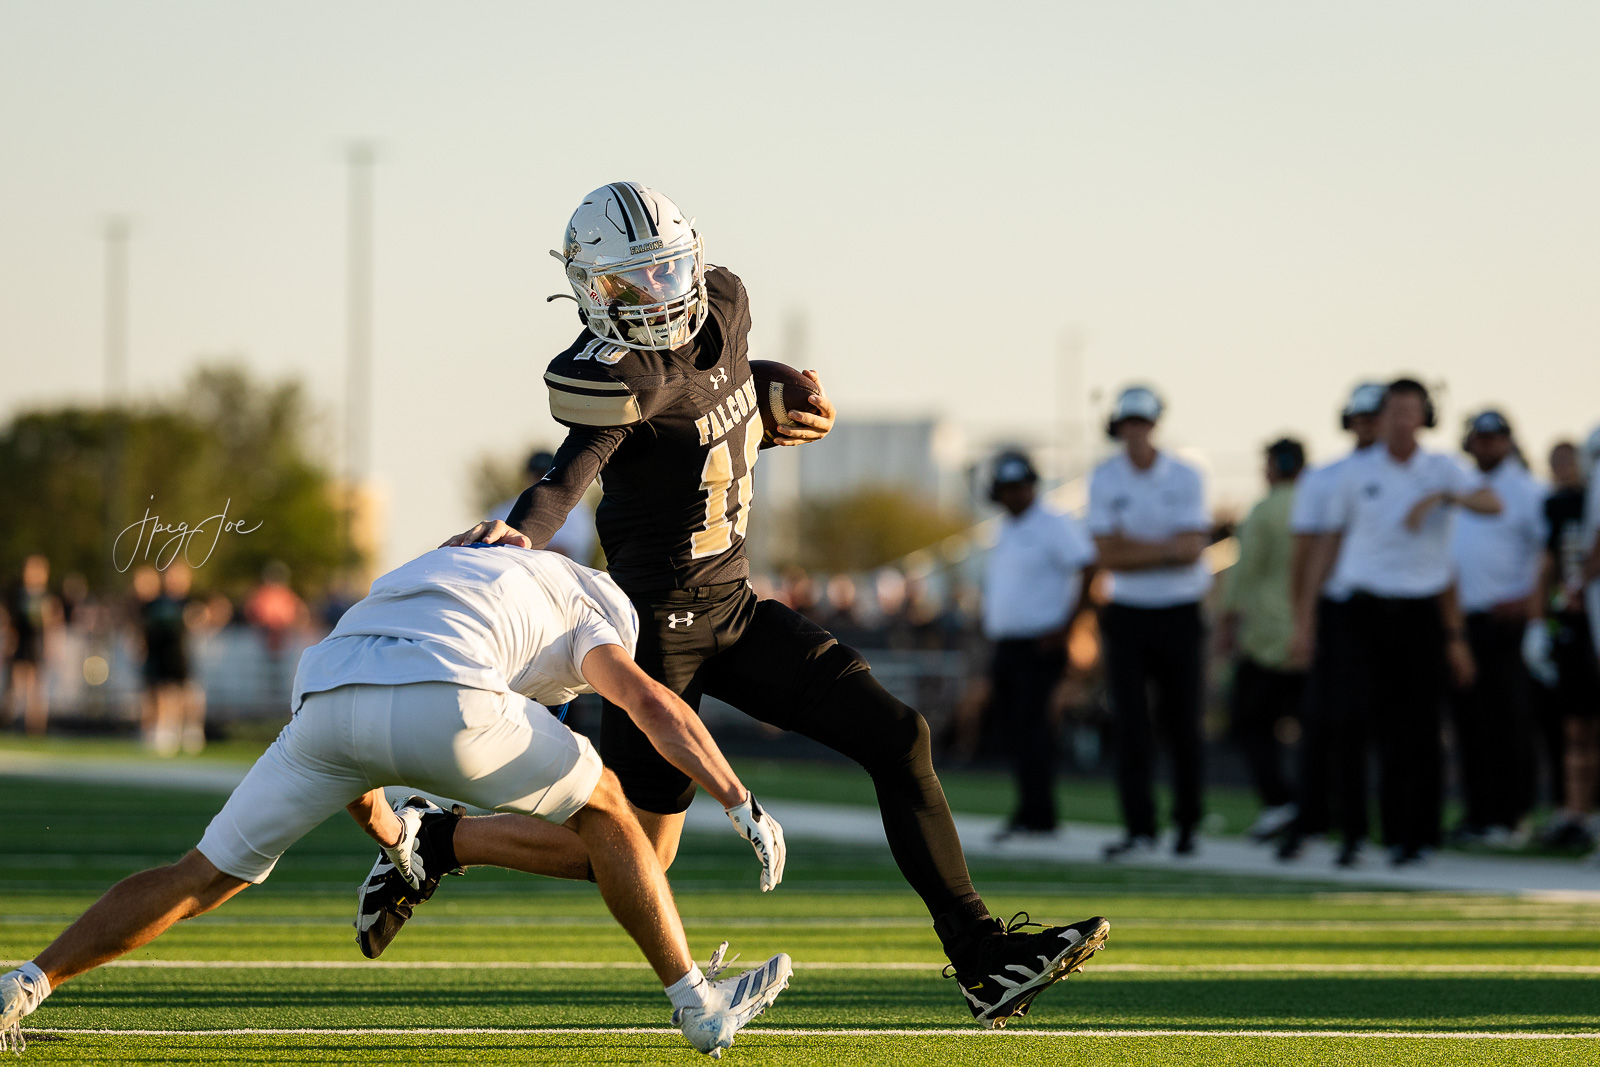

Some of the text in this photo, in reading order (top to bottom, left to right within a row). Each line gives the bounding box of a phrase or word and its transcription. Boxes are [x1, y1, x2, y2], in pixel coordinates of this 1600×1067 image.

[630, 240, 664, 255] FALCONS
[573, 337, 631, 365] 10
[694, 373, 757, 447] FALCON
